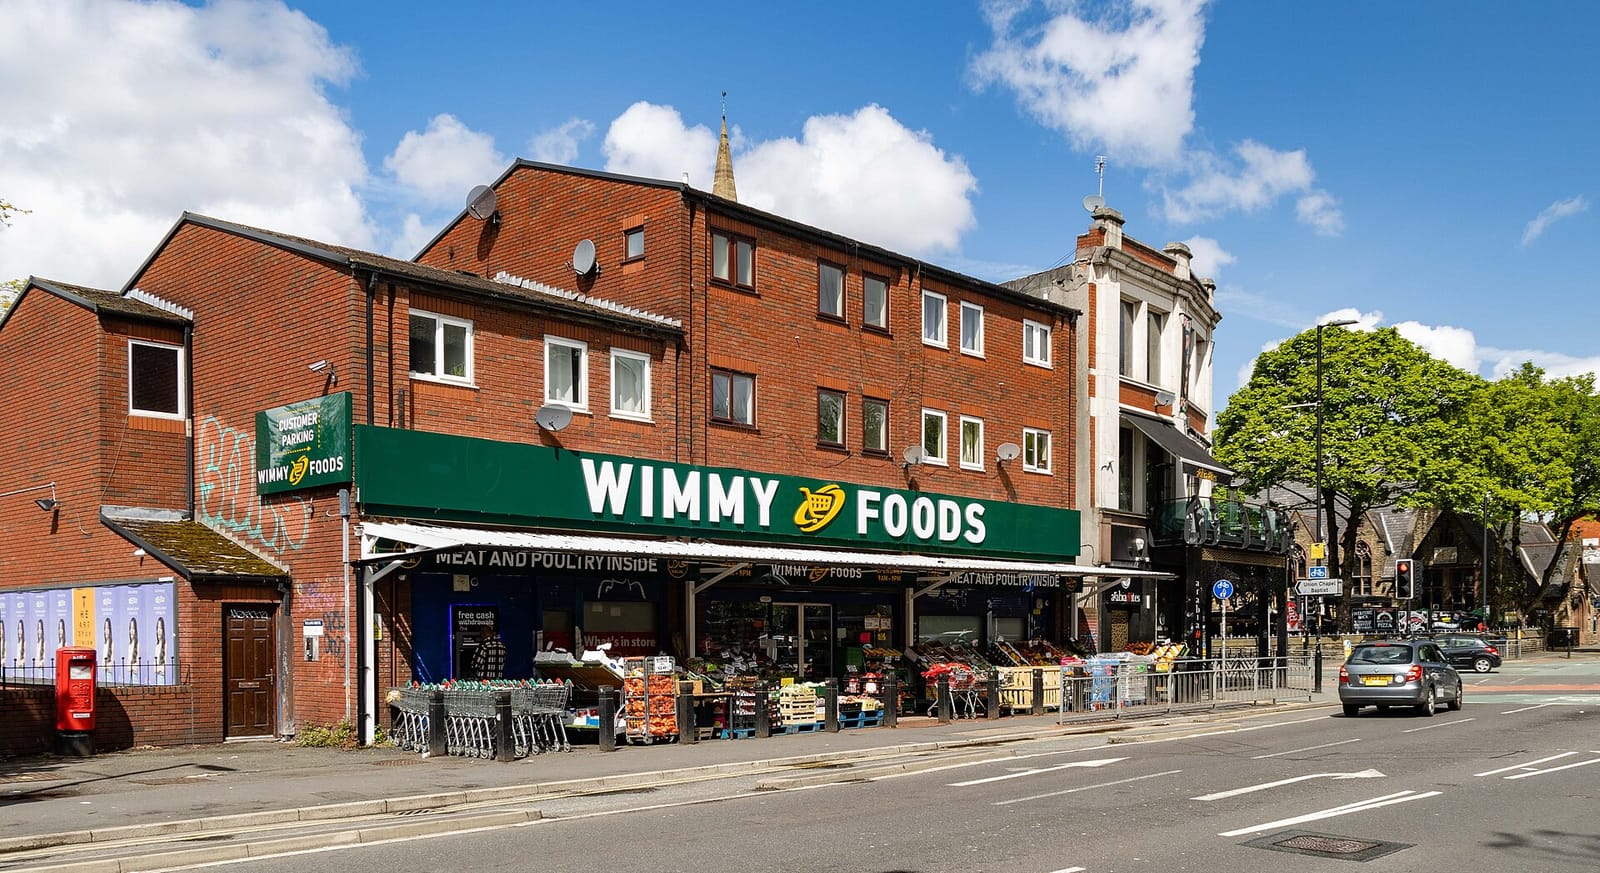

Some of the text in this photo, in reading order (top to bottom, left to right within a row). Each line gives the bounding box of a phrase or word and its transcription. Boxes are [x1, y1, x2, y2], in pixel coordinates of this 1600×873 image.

[279, 412, 318, 431] CUSTOMER
[282, 430, 314, 447] PARKING
[257, 456, 344, 484] WIMMY FOODS
[581, 458, 986, 544] WIMMY FOODS
[436, 550, 486, 566] MEAT
[489, 551, 528, 568] AND
[531, 553, 605, 571] POULTRY
[607, 557, 658, 573] INSIDE
[771, 564, 808, 578] WIMMY
[830, 566, 862, 579] FOODS
[949, 572, 975, 584] MEAT
[975, 573, 995, 586] AND
[996, 574, 1032, 588] POULTRY
[1033, 575, 1060, 588] INSIDE
[458, 610, 495, 619] free cash
[584, 635, 657, 647] What's in store
